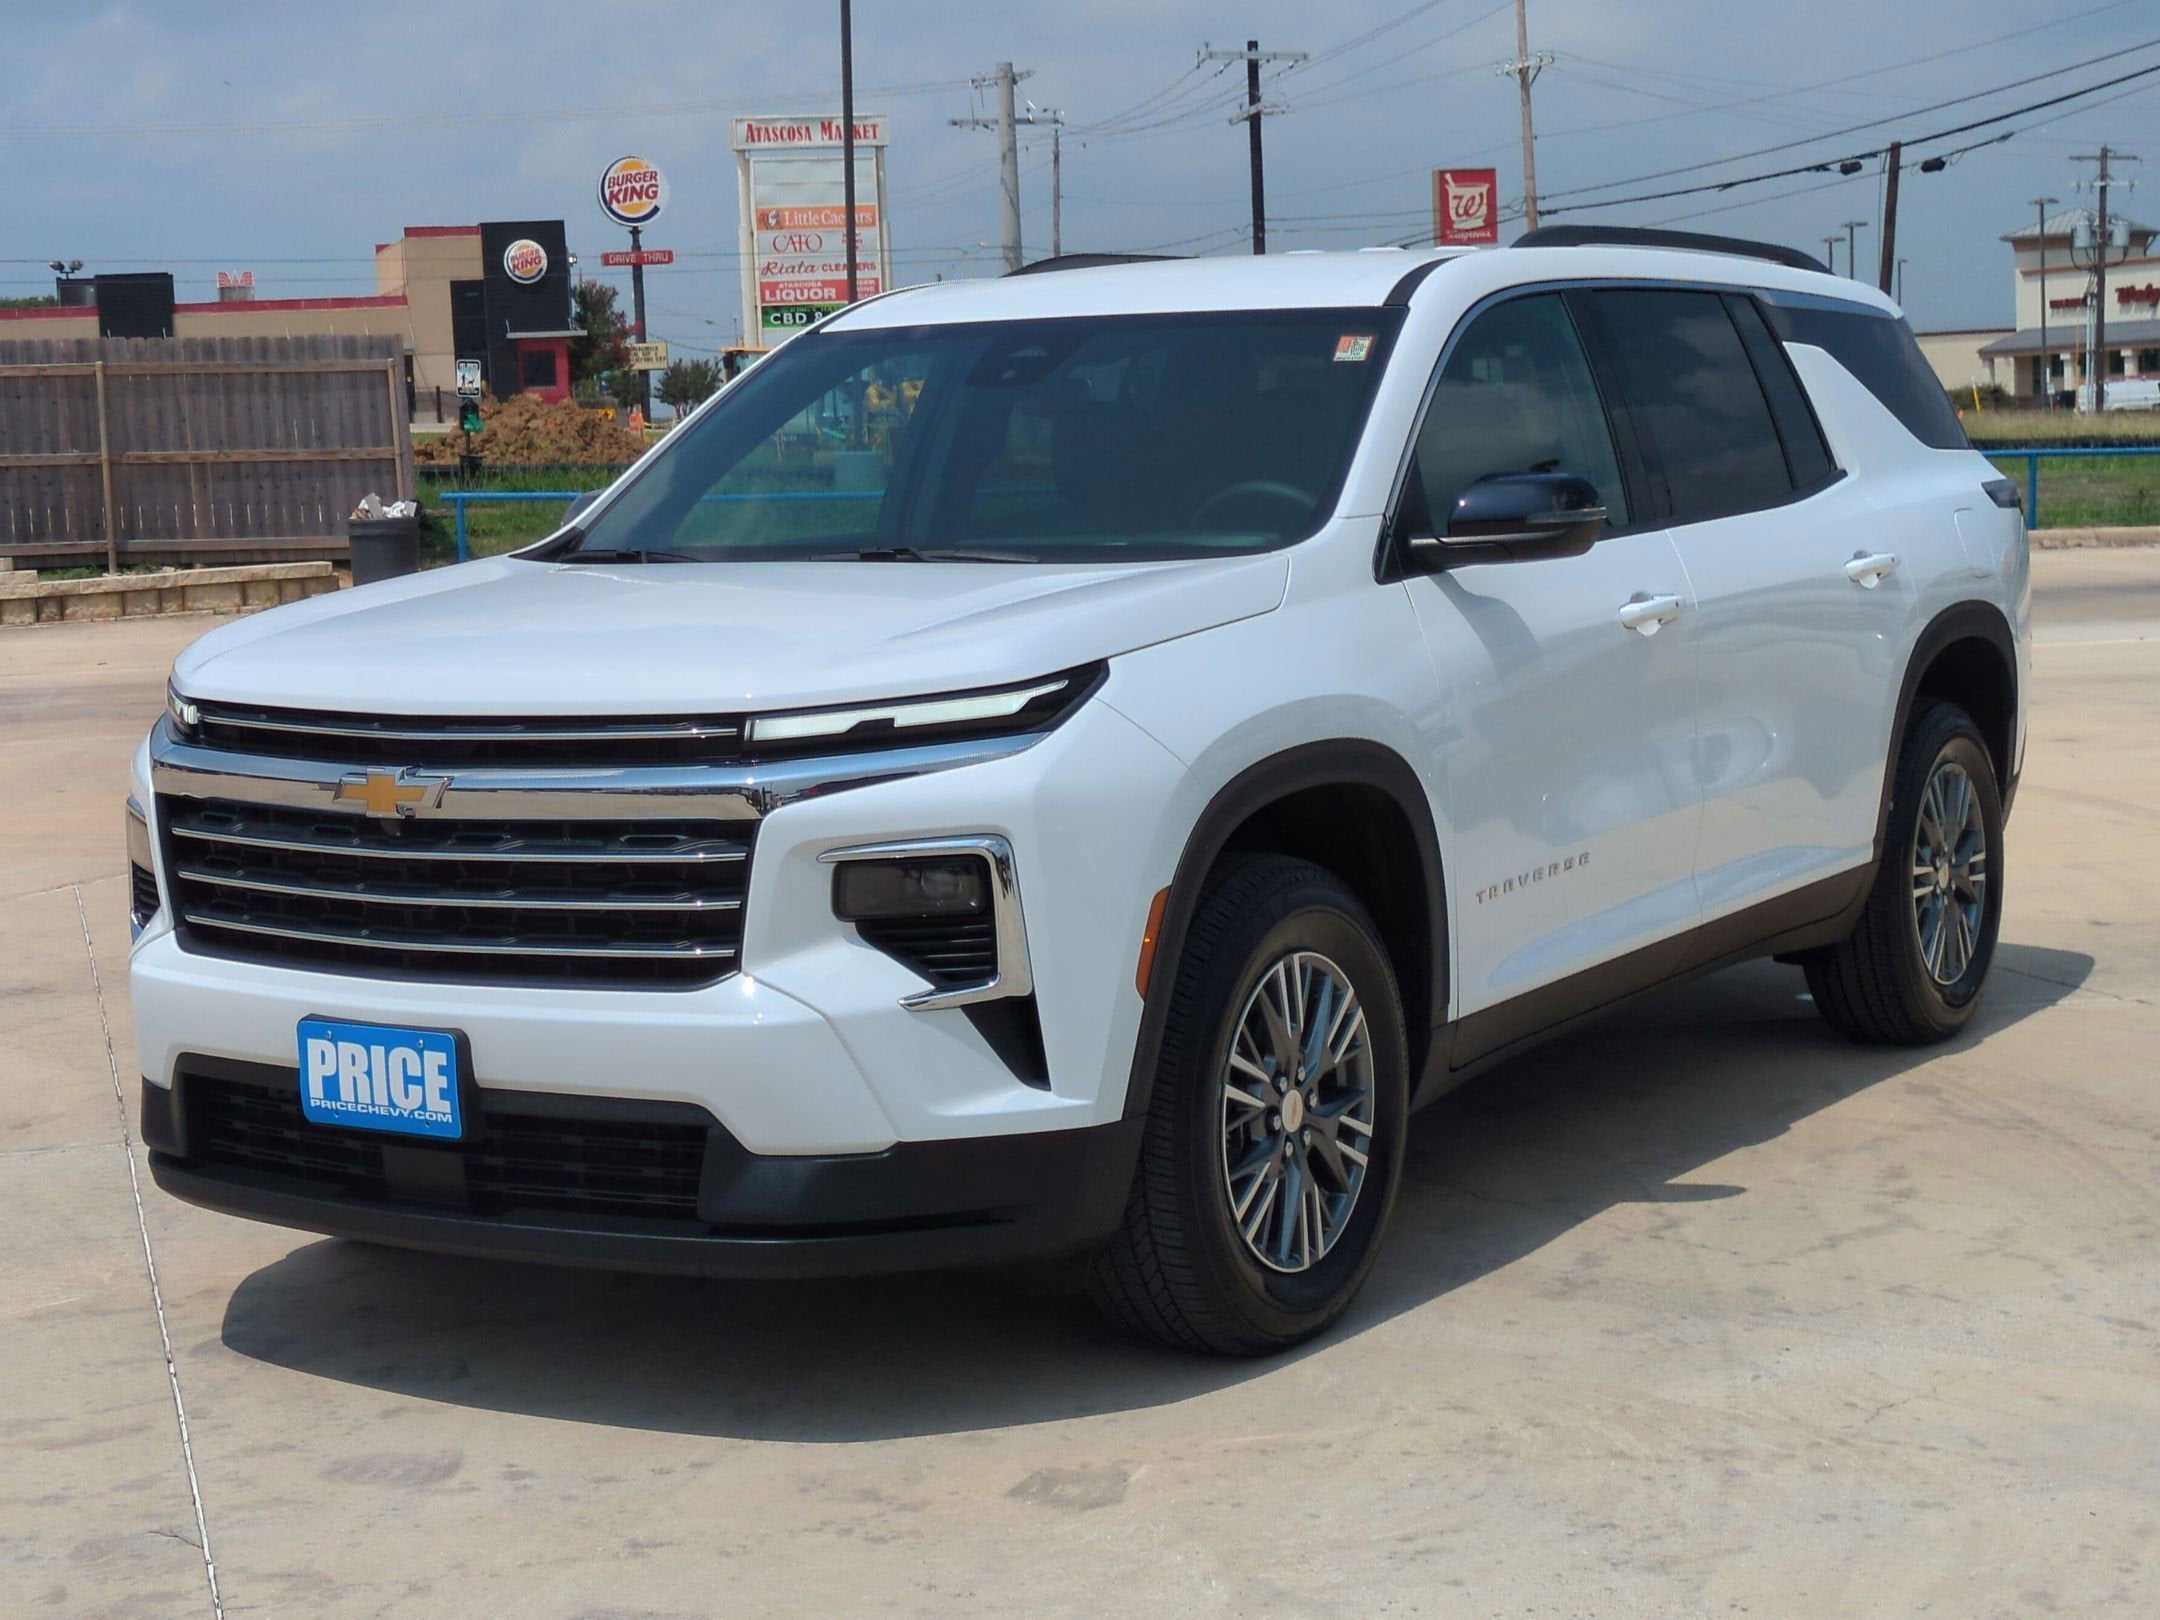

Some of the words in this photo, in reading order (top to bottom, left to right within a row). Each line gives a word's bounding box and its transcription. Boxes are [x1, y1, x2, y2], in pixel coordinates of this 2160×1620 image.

[745, 123, 813, 143] ATASCOSA
[820, 120, 880, 140] MAKET
[607, 170, 658, 188] BURGER
[607, 183, 659, 206] KING
[783, 209, 820, 227] Little
[820, 208, 873, 225] Caers
[772, 233, 823, 253] CATO
[511, 255, 543, 273] KING
[609, 253, 637, 264] DRIVE
[643, 252, 669, 263] THRU
[761, 260, 818, 276] Riata
[821, 261, 877, 272] CLEAERS
[779, 281, 823, 289] ATASCOSA
[764, 287, 837, 302] LIQUOR
[769, 312, 807, 325] CBD
[1475, 851, 1590, 905] TRAVERSE
[306, 1038, 451, 1114] PRICE
[310, 1098, 453, 1124] PRICECHEVY.COM
